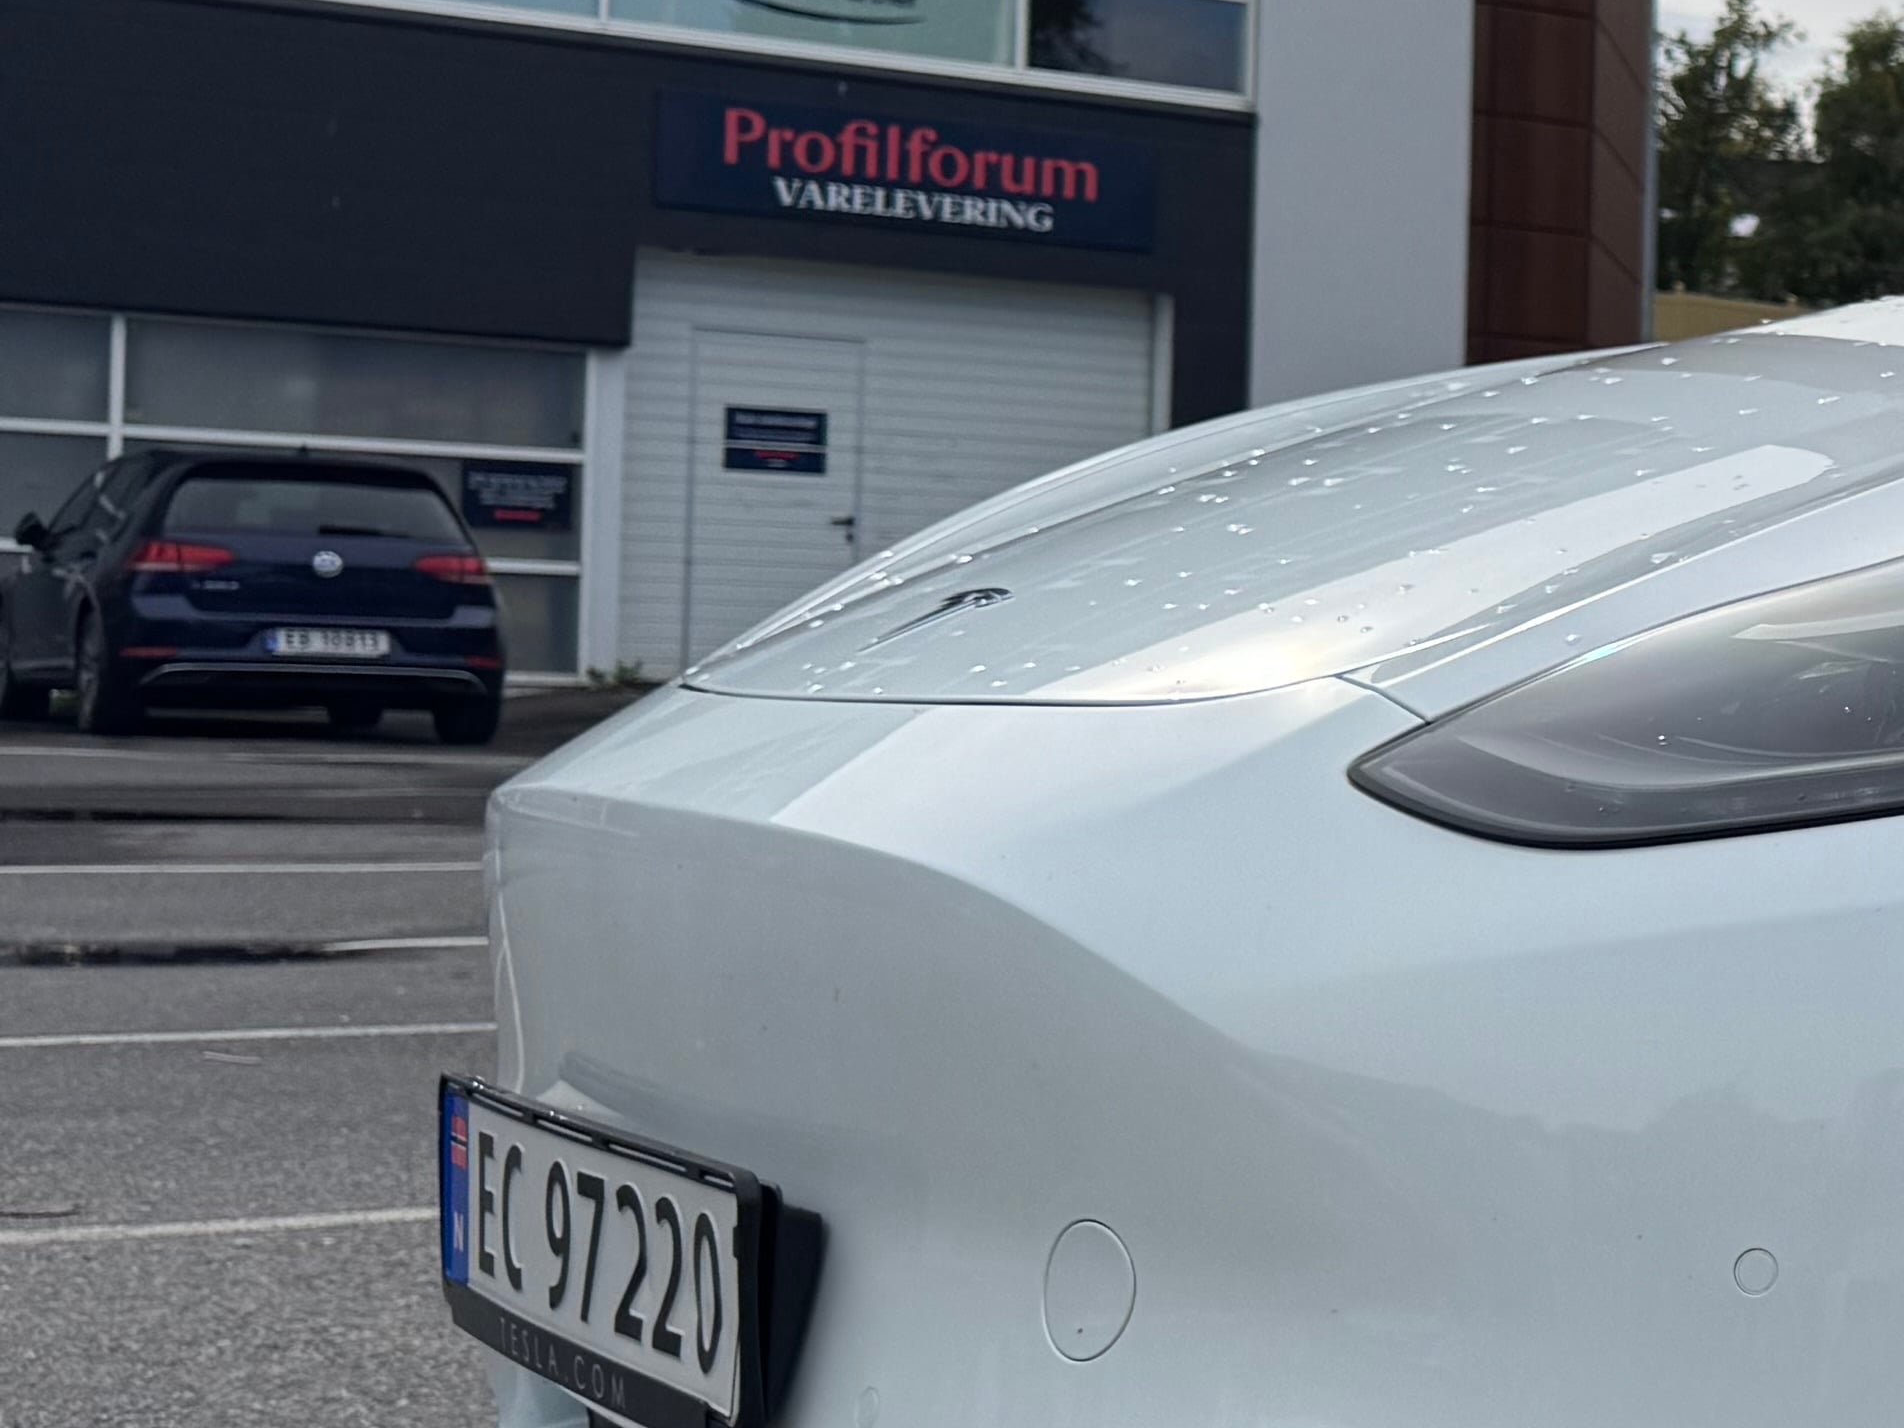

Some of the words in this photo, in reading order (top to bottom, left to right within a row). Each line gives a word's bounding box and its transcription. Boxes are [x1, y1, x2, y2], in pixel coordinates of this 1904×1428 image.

[723, 107, 1099, 203] Profilforum
[773, 176, 1054, 233] VARELEVERING
[452, 1212, 464, 1253] N
[478, 1130, 526, 1292] EC
[545, 1159, 724, 1374] 97220
[500, 1317, 627, 1410] TESLA.COM
